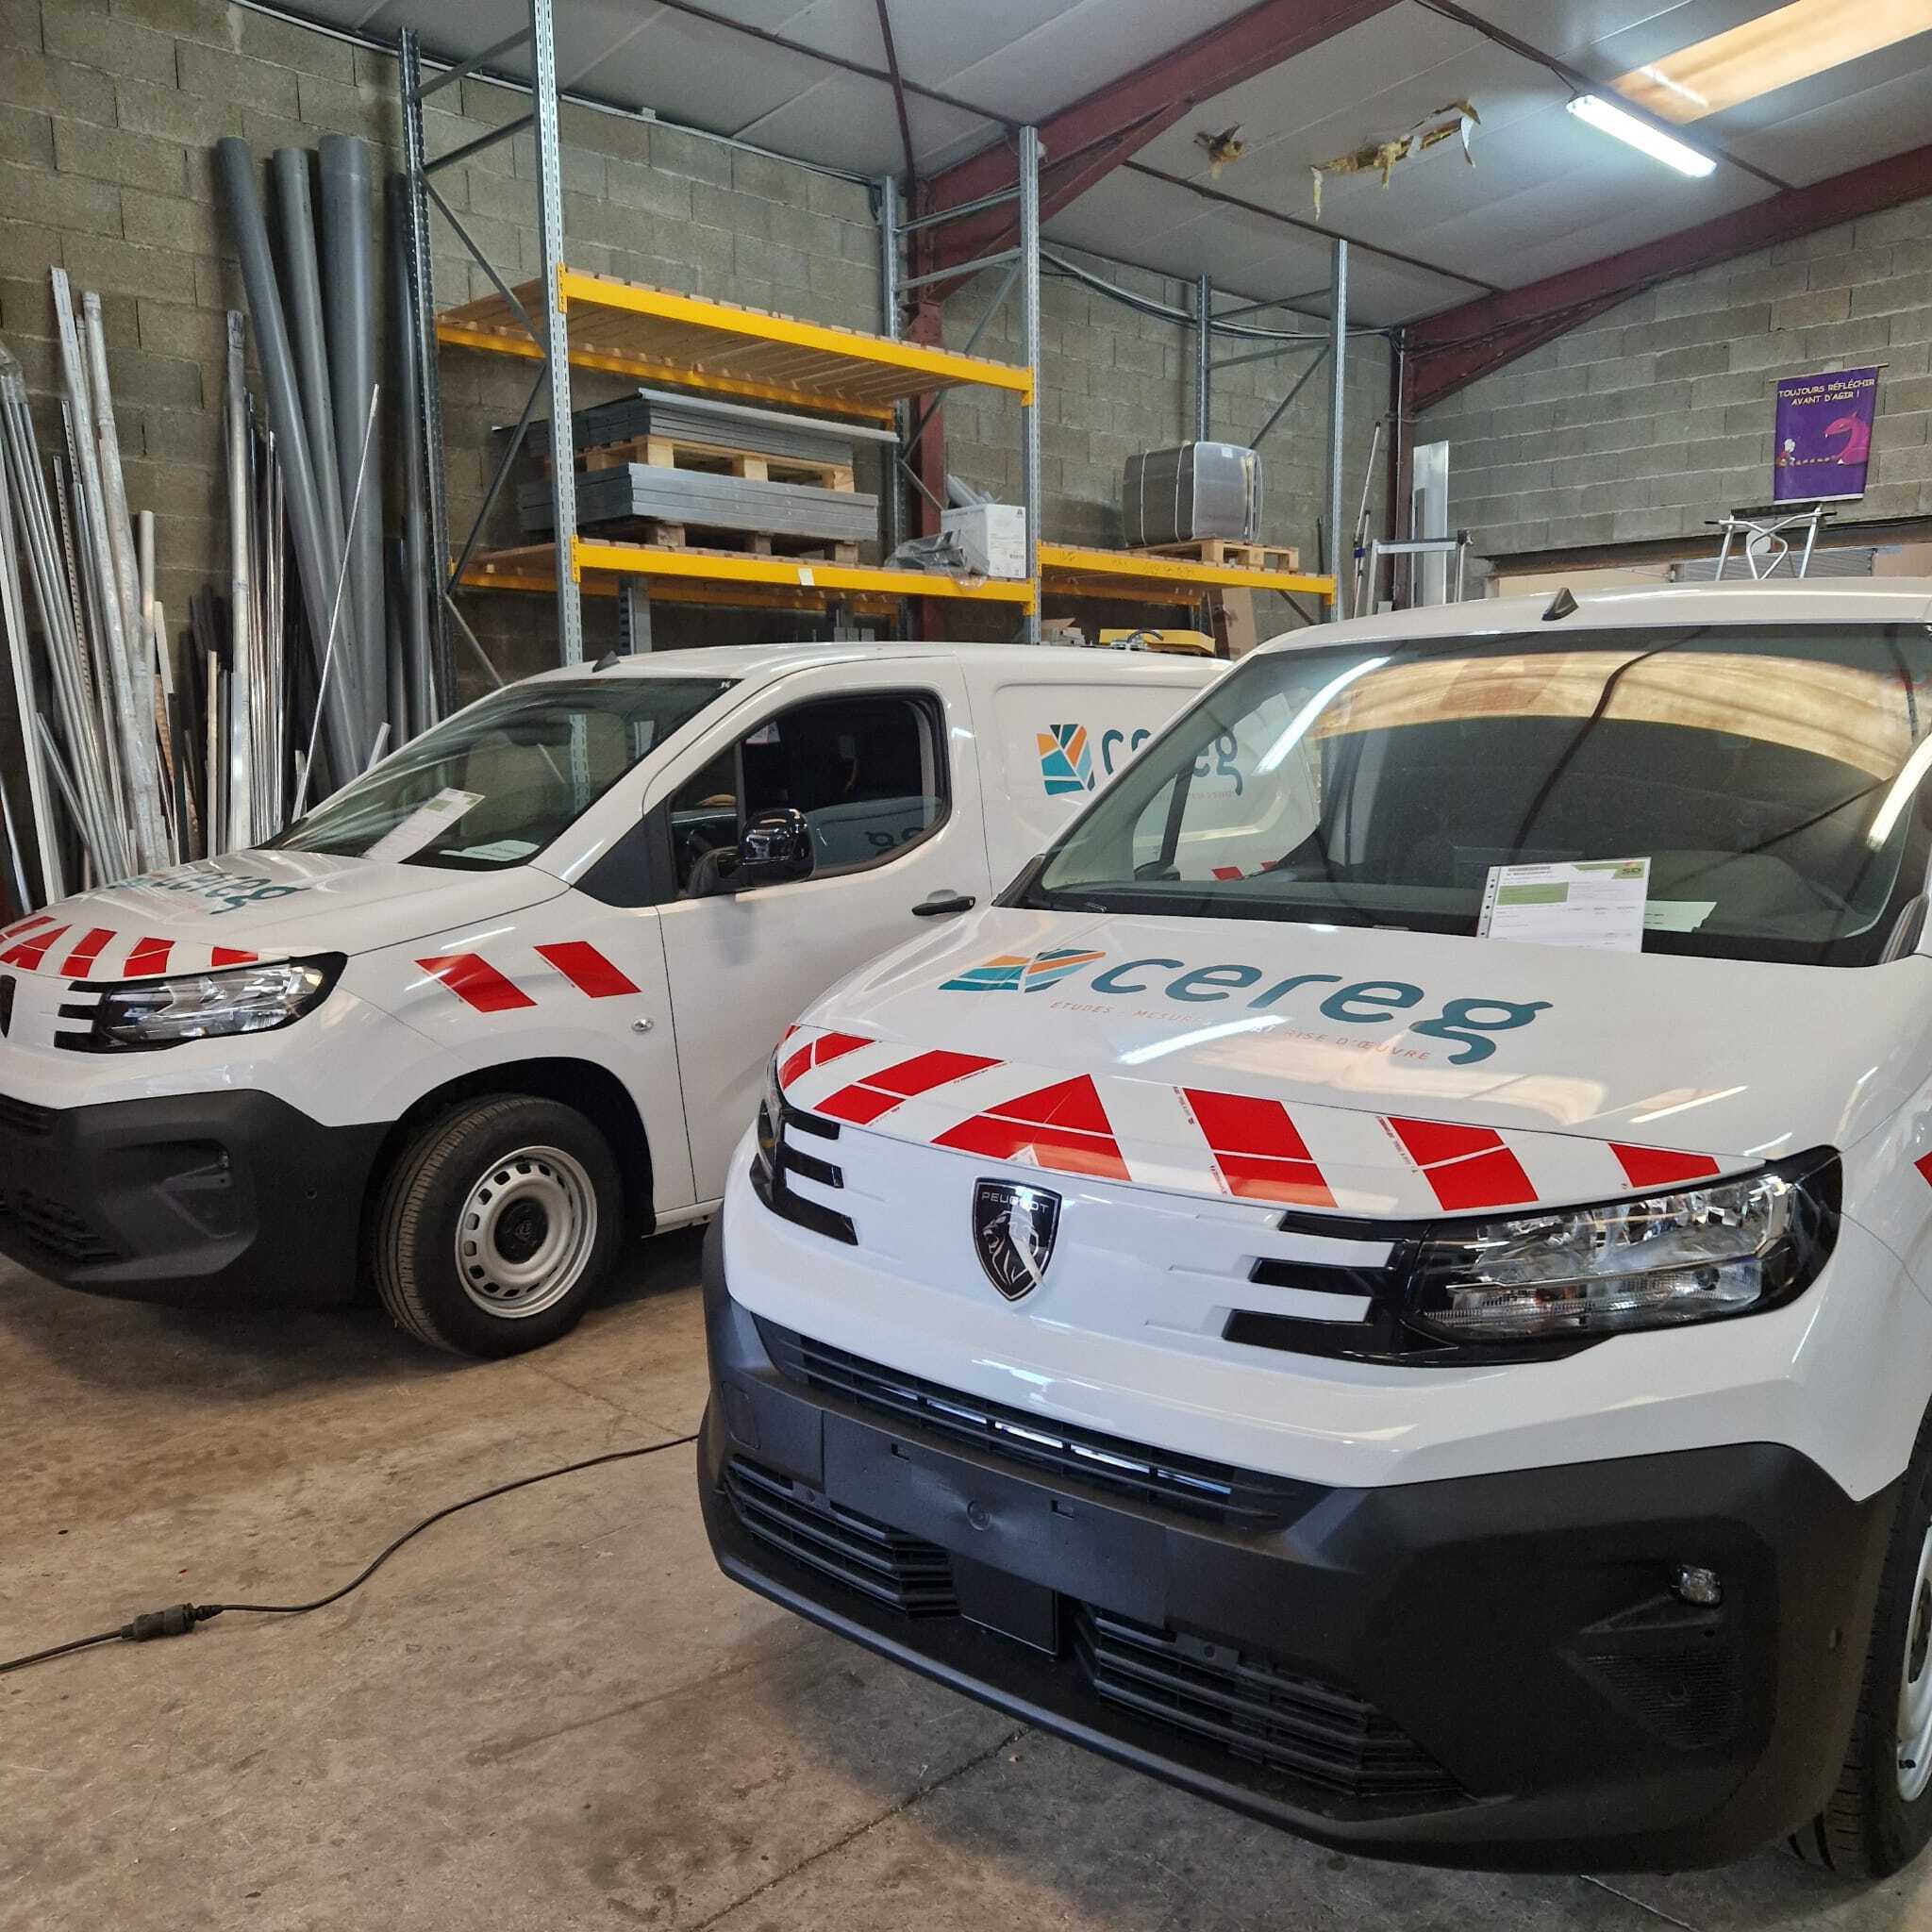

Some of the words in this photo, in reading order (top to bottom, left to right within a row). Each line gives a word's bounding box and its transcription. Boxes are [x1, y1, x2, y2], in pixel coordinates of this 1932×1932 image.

[1779, 386, 1825, 397] TOUJOURS
[1791, 394, 1822, 407] AVANT
[1824, 391, 1854, 402] D'AGIR
[1091, 958, 1554, 1065] cereg
